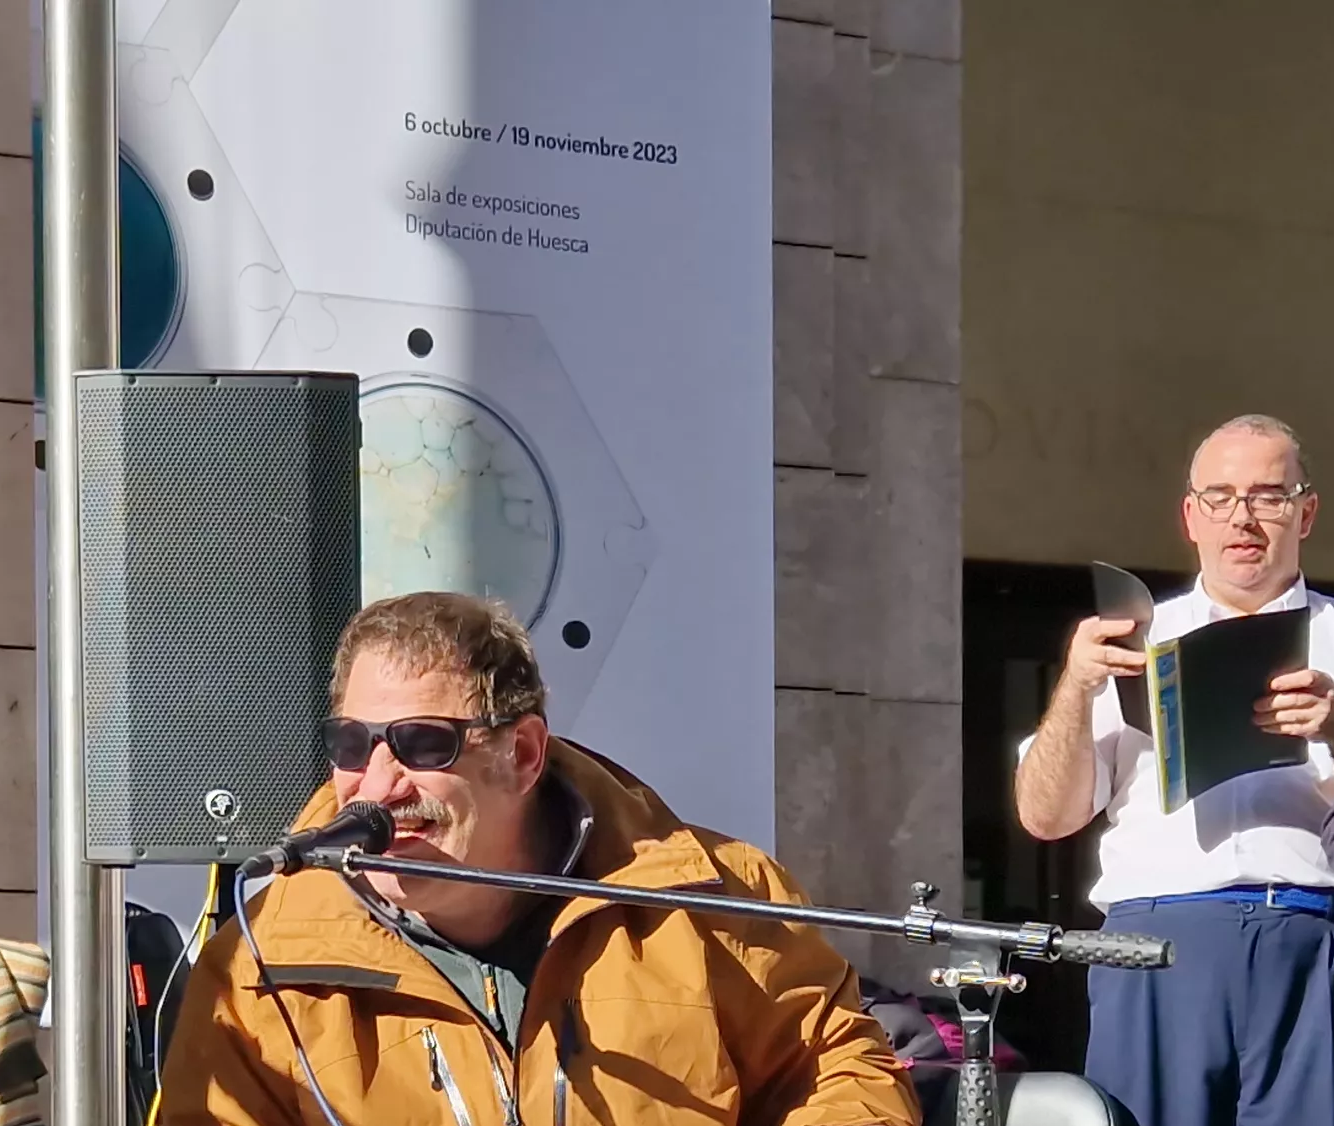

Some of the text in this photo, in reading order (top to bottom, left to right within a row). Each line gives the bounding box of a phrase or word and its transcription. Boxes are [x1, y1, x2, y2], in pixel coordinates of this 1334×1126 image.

[405, 112, 417, 131] 6
[421, 118, 492, 141] octubre
[511, 126, 530, 146] 19
[534, 132, 629, 159] noviembre
[632, 141, 678, 165] 2023
[405, 180, 581, 220] Sala de exposiciones
[405, 213, 589, 253] Diputación de Huesca
